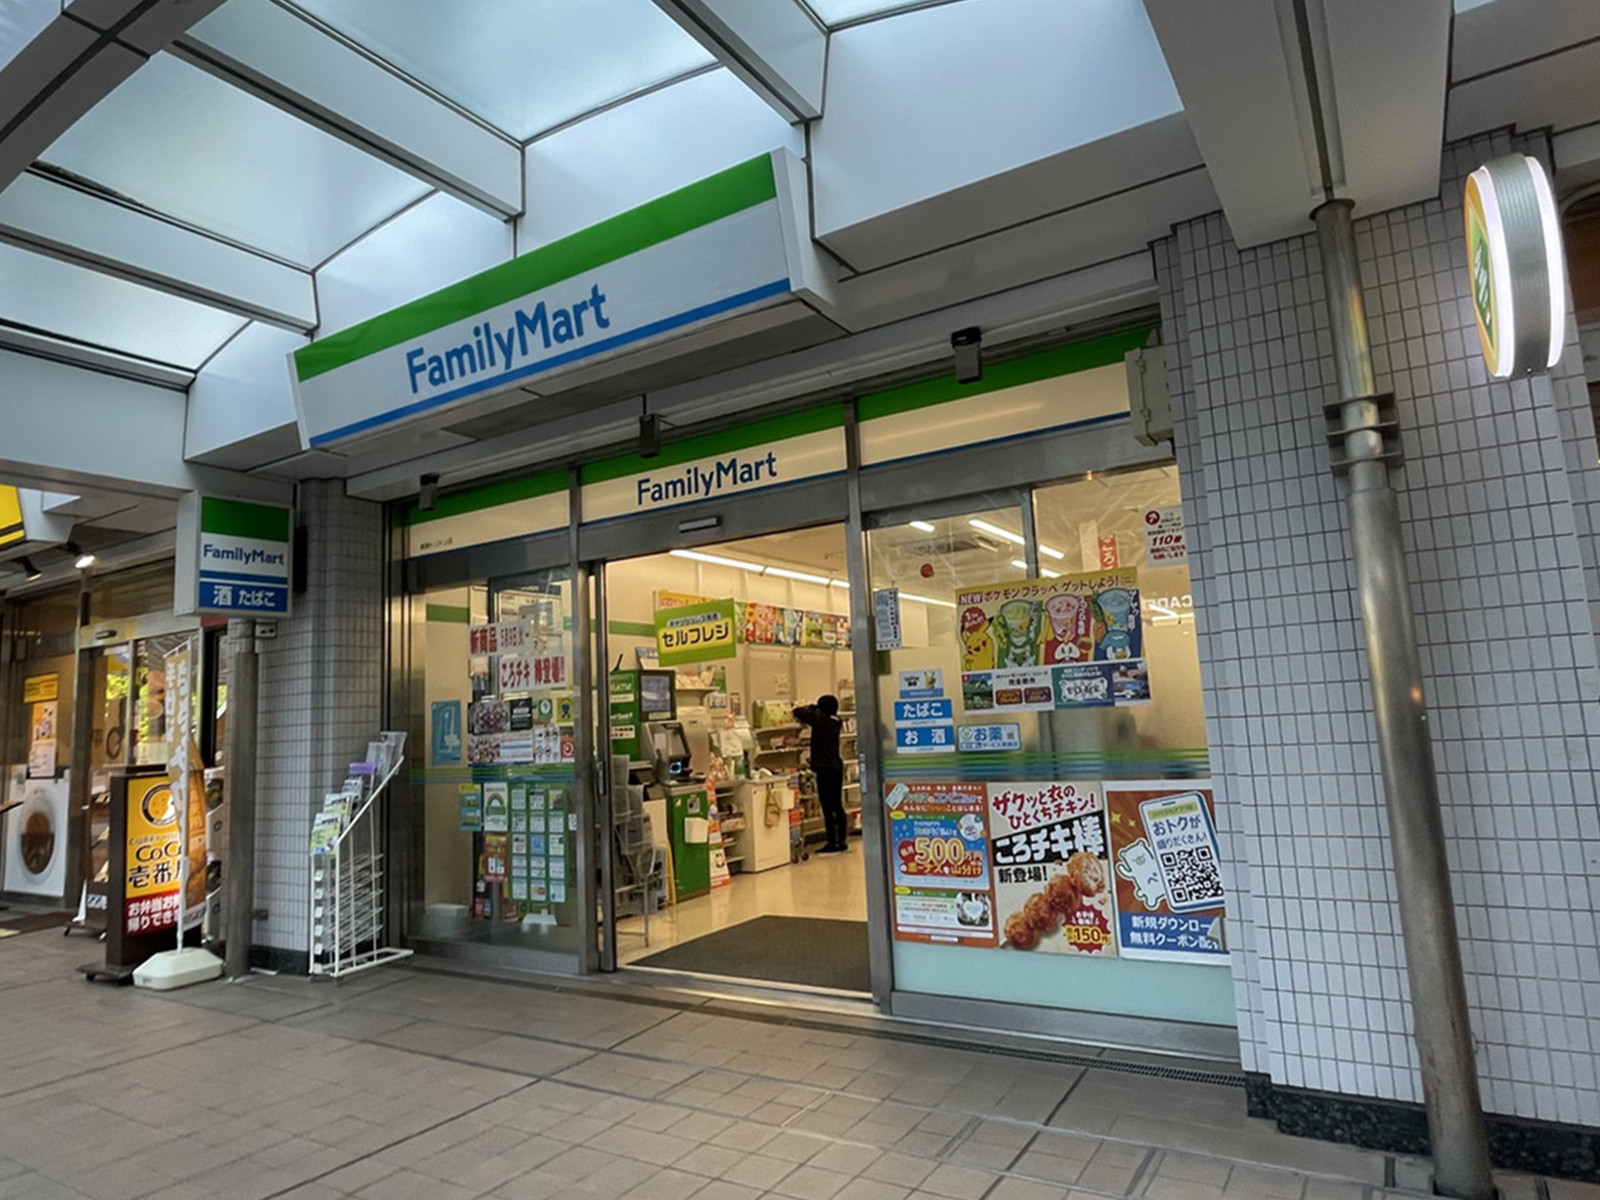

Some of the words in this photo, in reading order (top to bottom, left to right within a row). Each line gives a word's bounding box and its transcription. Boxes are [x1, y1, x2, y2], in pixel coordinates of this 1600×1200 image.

[405, 283, 610, 394] FamilyMart
[637, 451, 778, 506] FamilyMart
[203, 543, 285, 566] FamilyMart
[213, 585, 233, 606] 酒
[238, 589, 276, 608] たばこ
[959, 591, 984, 606] NEW
[470, 627, 498, 654] 新商品
[661, 621, 730, 648] セルフレジ
[902, 702, 943, 718] たばこ
[974, 727, 1003, 741] お薬
[993, 784, 1076, 816] ザクッと衣の
[1008, 793, 1096, 830] ひとくちチキン!
[1152, 815, 1201, 836] おトクが
[995, 815, 1104, 864] ころチキ棒
[998, 865, 1048, 883] 新登場!
